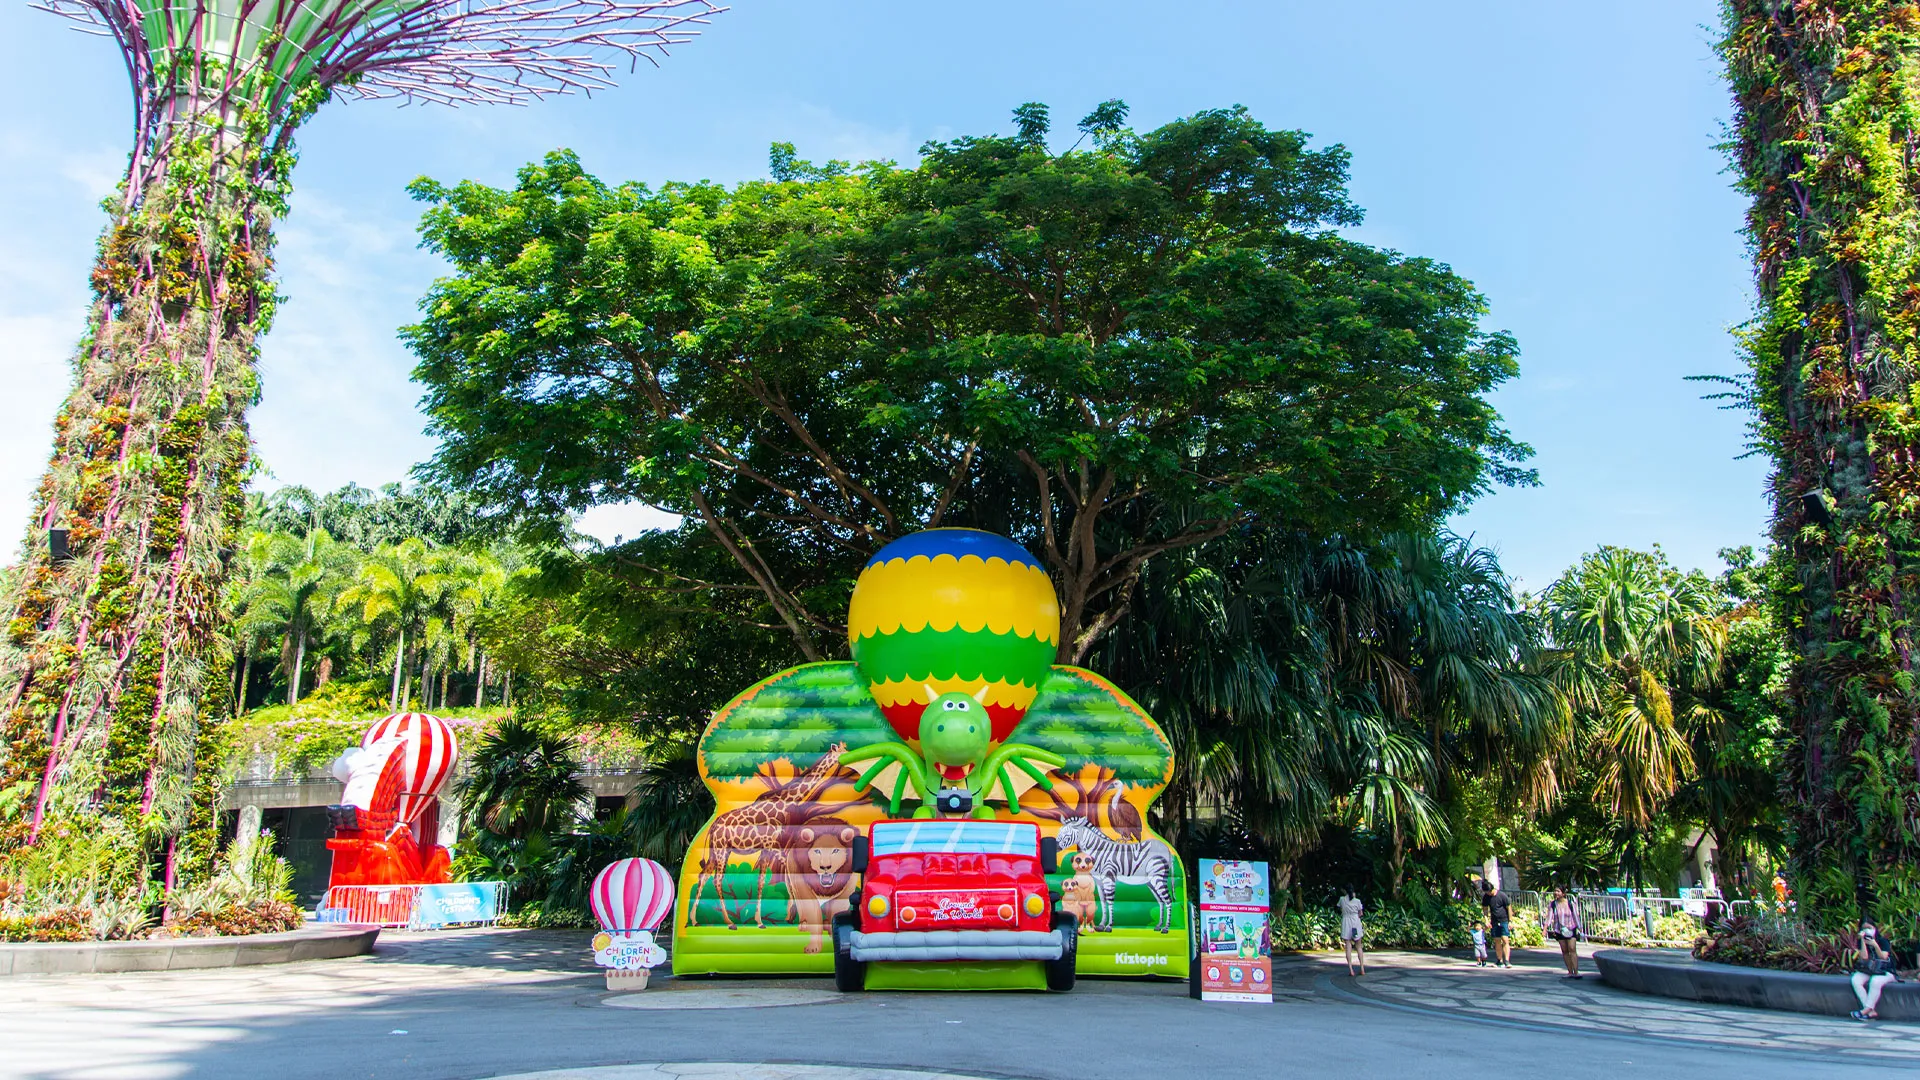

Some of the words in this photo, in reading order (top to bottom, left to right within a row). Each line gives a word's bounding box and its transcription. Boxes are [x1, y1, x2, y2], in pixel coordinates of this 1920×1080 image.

[940, 898, 975, 910] Around
[931, 908, 949, 921] The
[950, 907, 984, 919] World
[612, 955, 651, 966] FESTIVAL
[1115, 952, 1168, 967] Kiztopia
